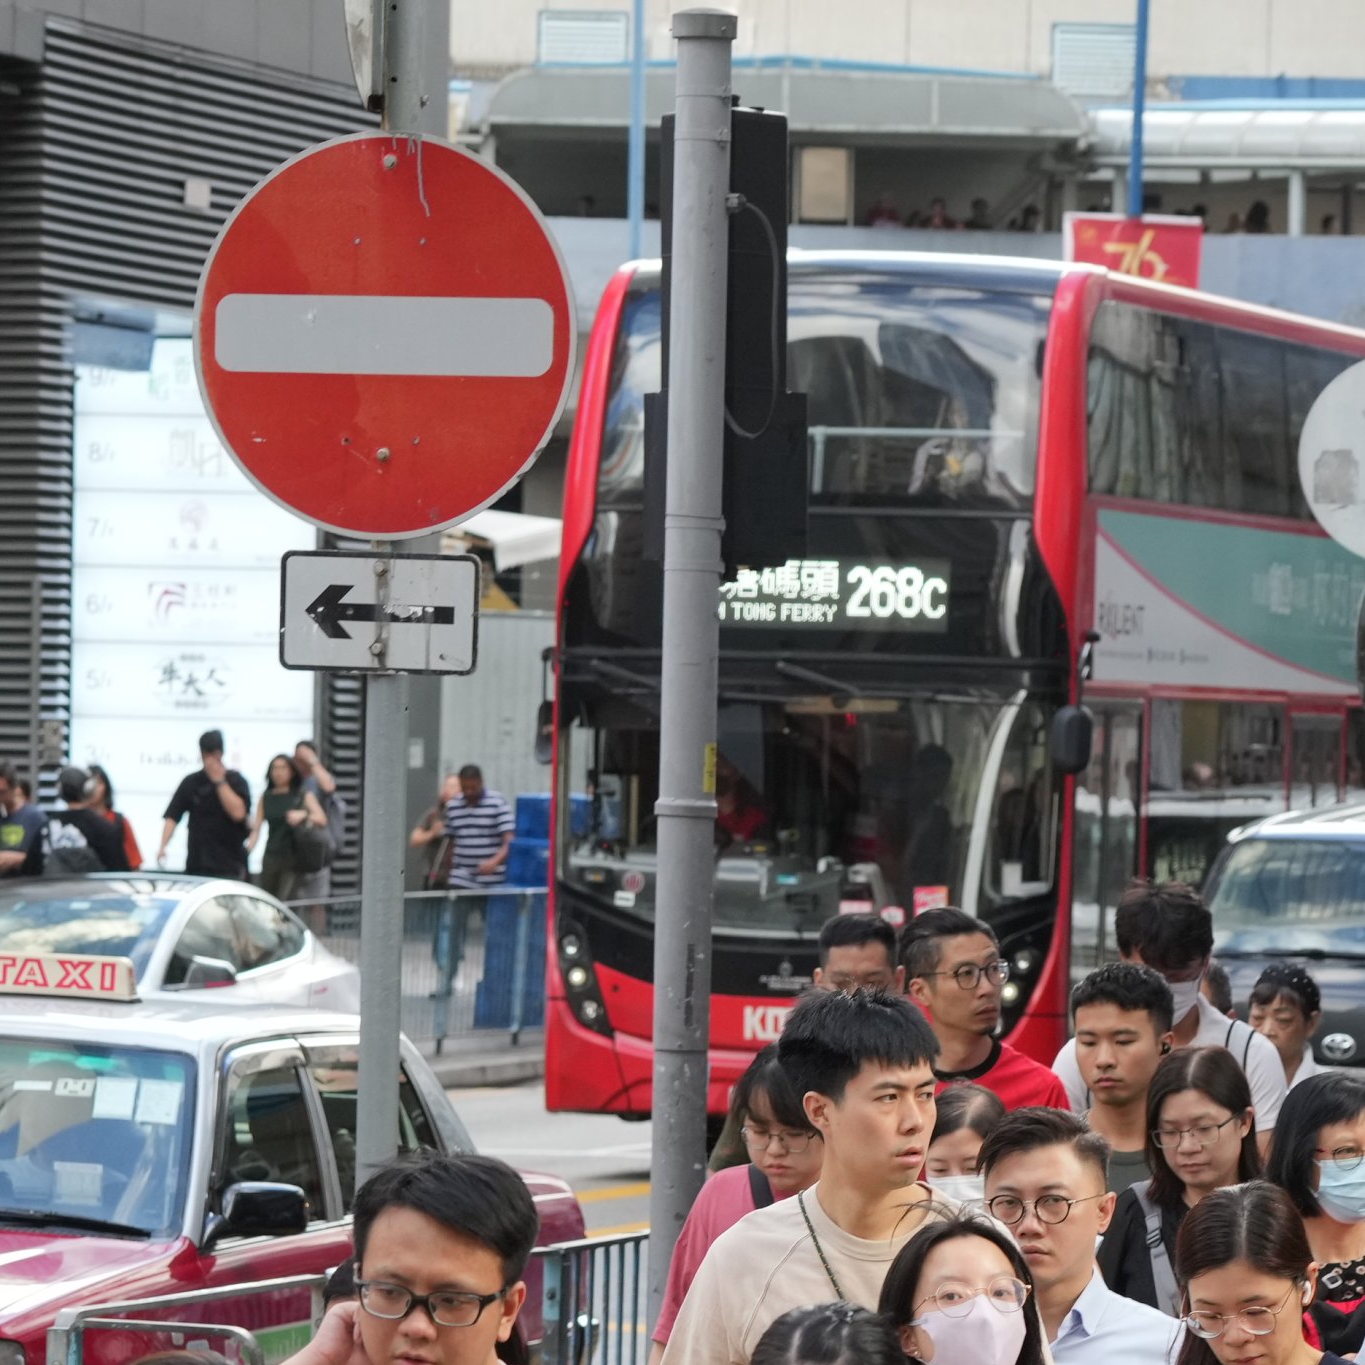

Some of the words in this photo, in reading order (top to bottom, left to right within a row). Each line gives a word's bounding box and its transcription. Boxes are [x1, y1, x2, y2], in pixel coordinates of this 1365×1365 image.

[846, 565, 947, 618] 268C
[731, 601, 776, 621] TONG
[780, 602, 837, 622] FERRY
